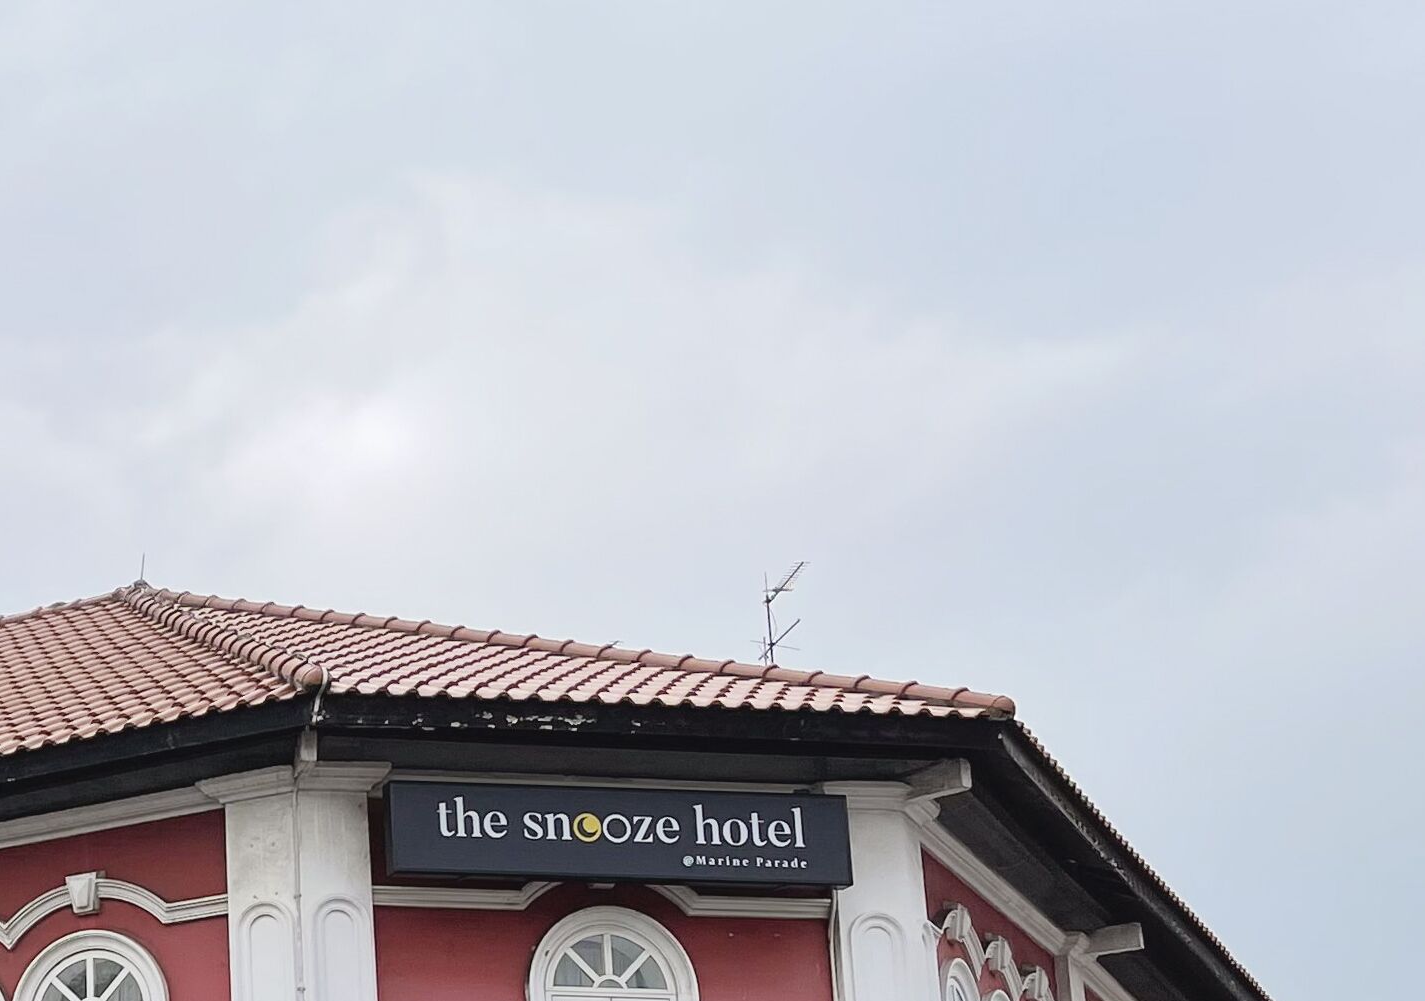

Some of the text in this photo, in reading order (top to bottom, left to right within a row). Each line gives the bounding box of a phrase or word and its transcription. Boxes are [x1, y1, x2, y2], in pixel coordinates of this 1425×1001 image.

[436, 797, 807, 848] the snooze hotel
[683, 854, 808, 870] @Marine Parade
